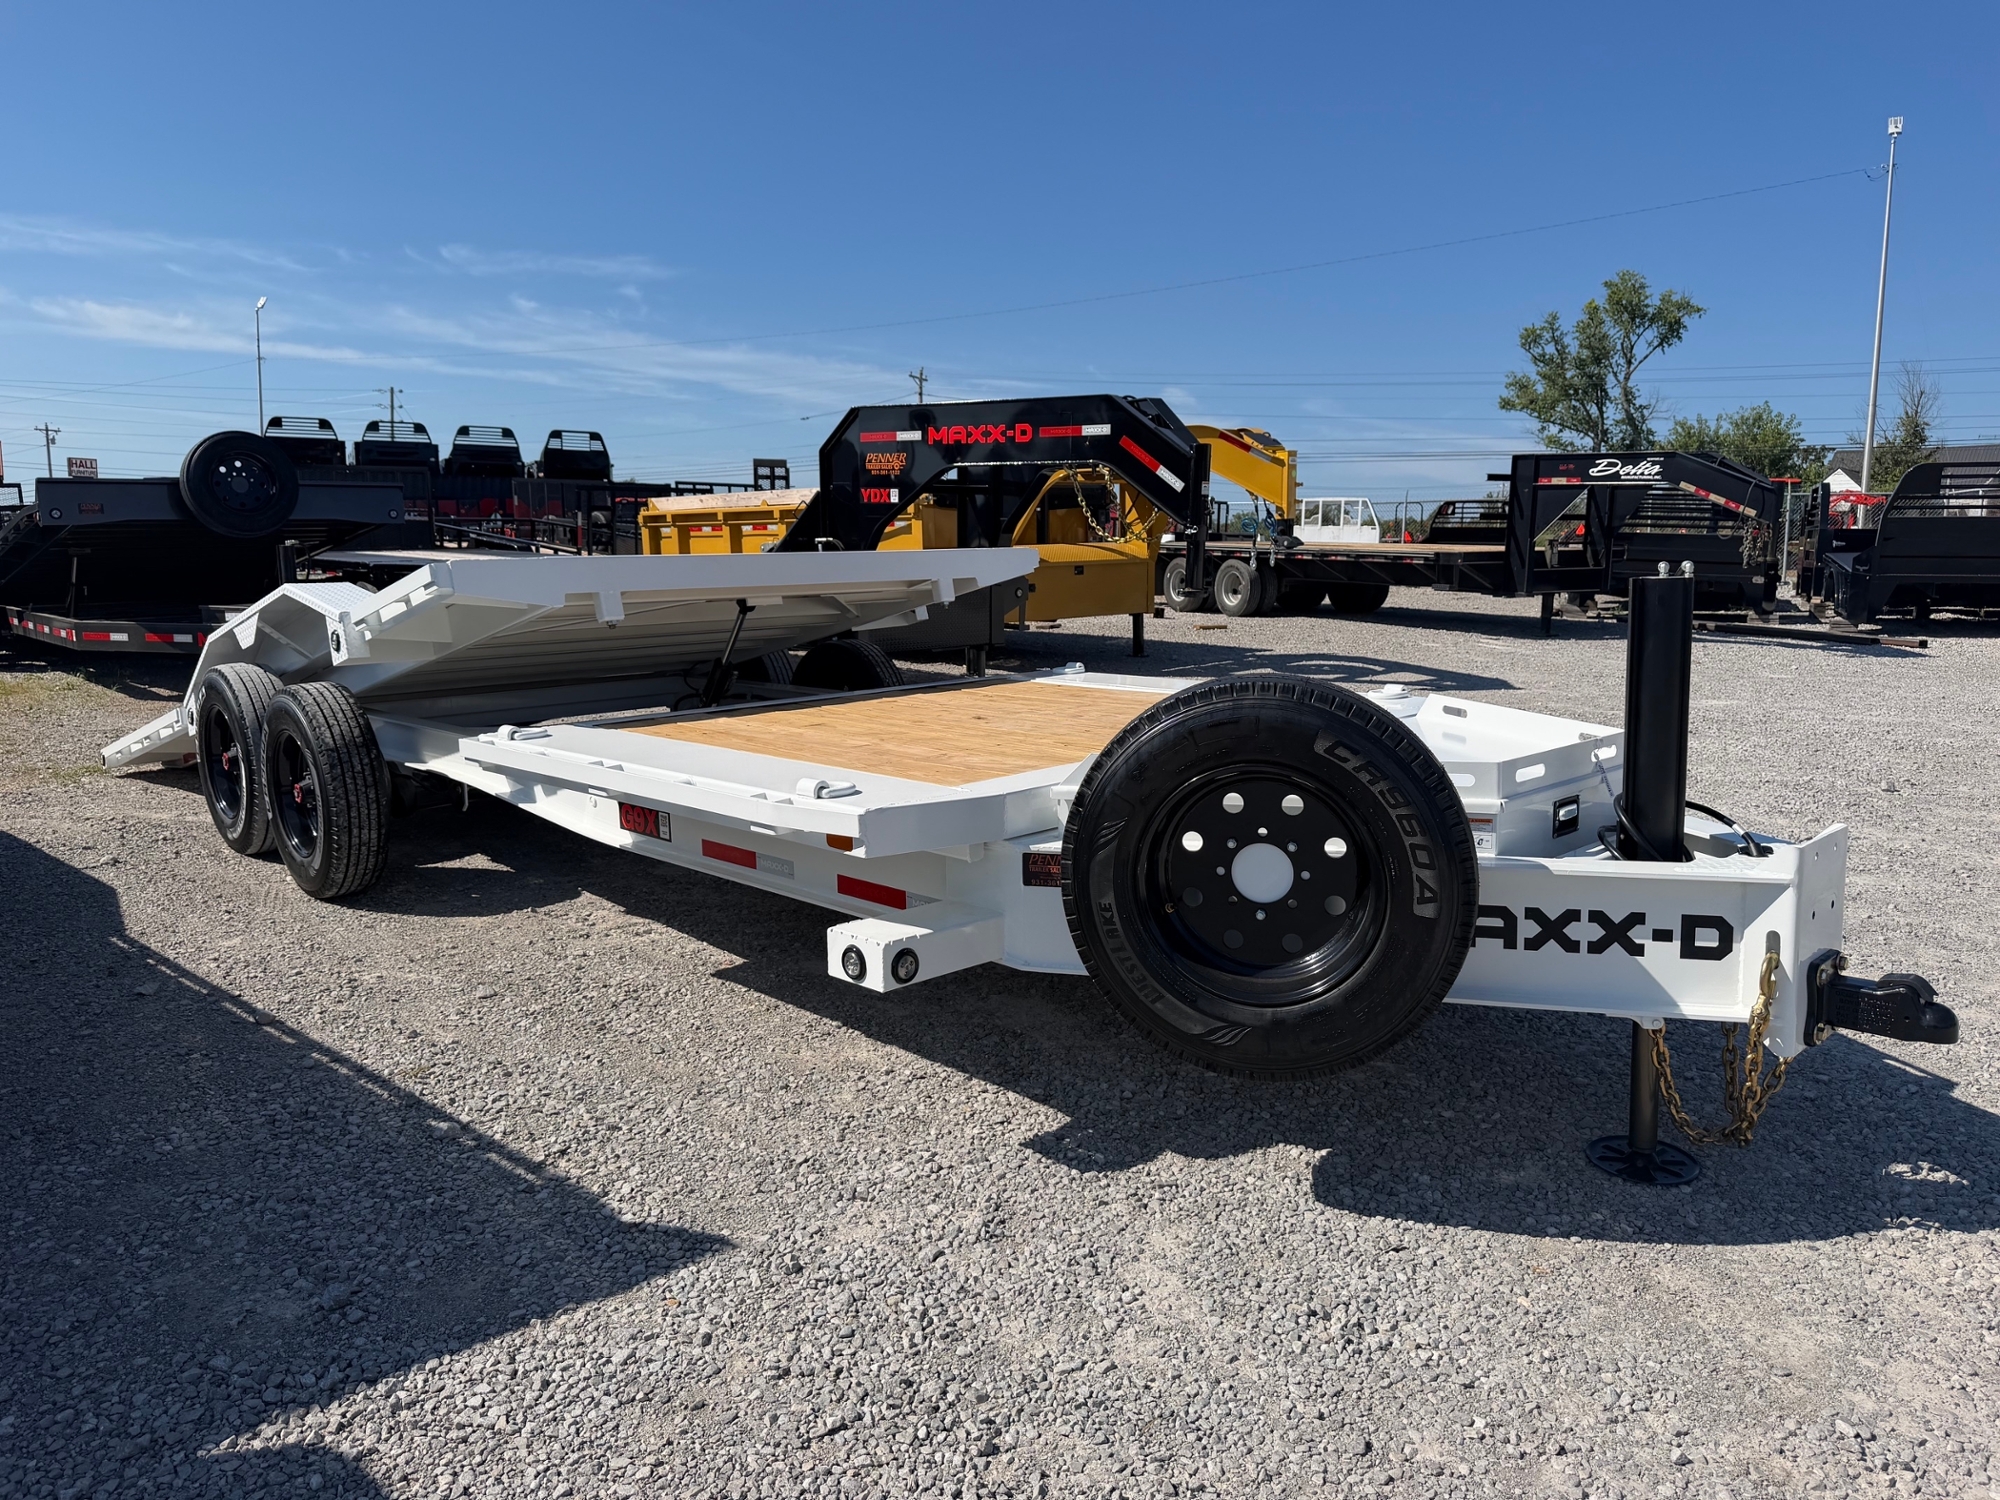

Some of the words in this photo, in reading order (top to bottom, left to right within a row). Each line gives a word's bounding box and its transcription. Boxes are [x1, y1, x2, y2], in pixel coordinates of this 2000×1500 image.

[928, 423, 1033, 445] MAXX-D
[71, 459, 96, 469] HALL
[865, 452, 907, 463] PENNER
[1588, 458, 1664, 477] Delta
[861, 488, 890, 503] YDX
[620, 804, 659, 837] G9X
[1323, 739, 1439, 906] CR960A
[760, 858, 789, 874] MAXX-D
[1029, 854, 1062, 866] PEN
[1469, 904, 1735, 962] AXX-D
[1097, 901, 1167, 1005] WESTLAKE
